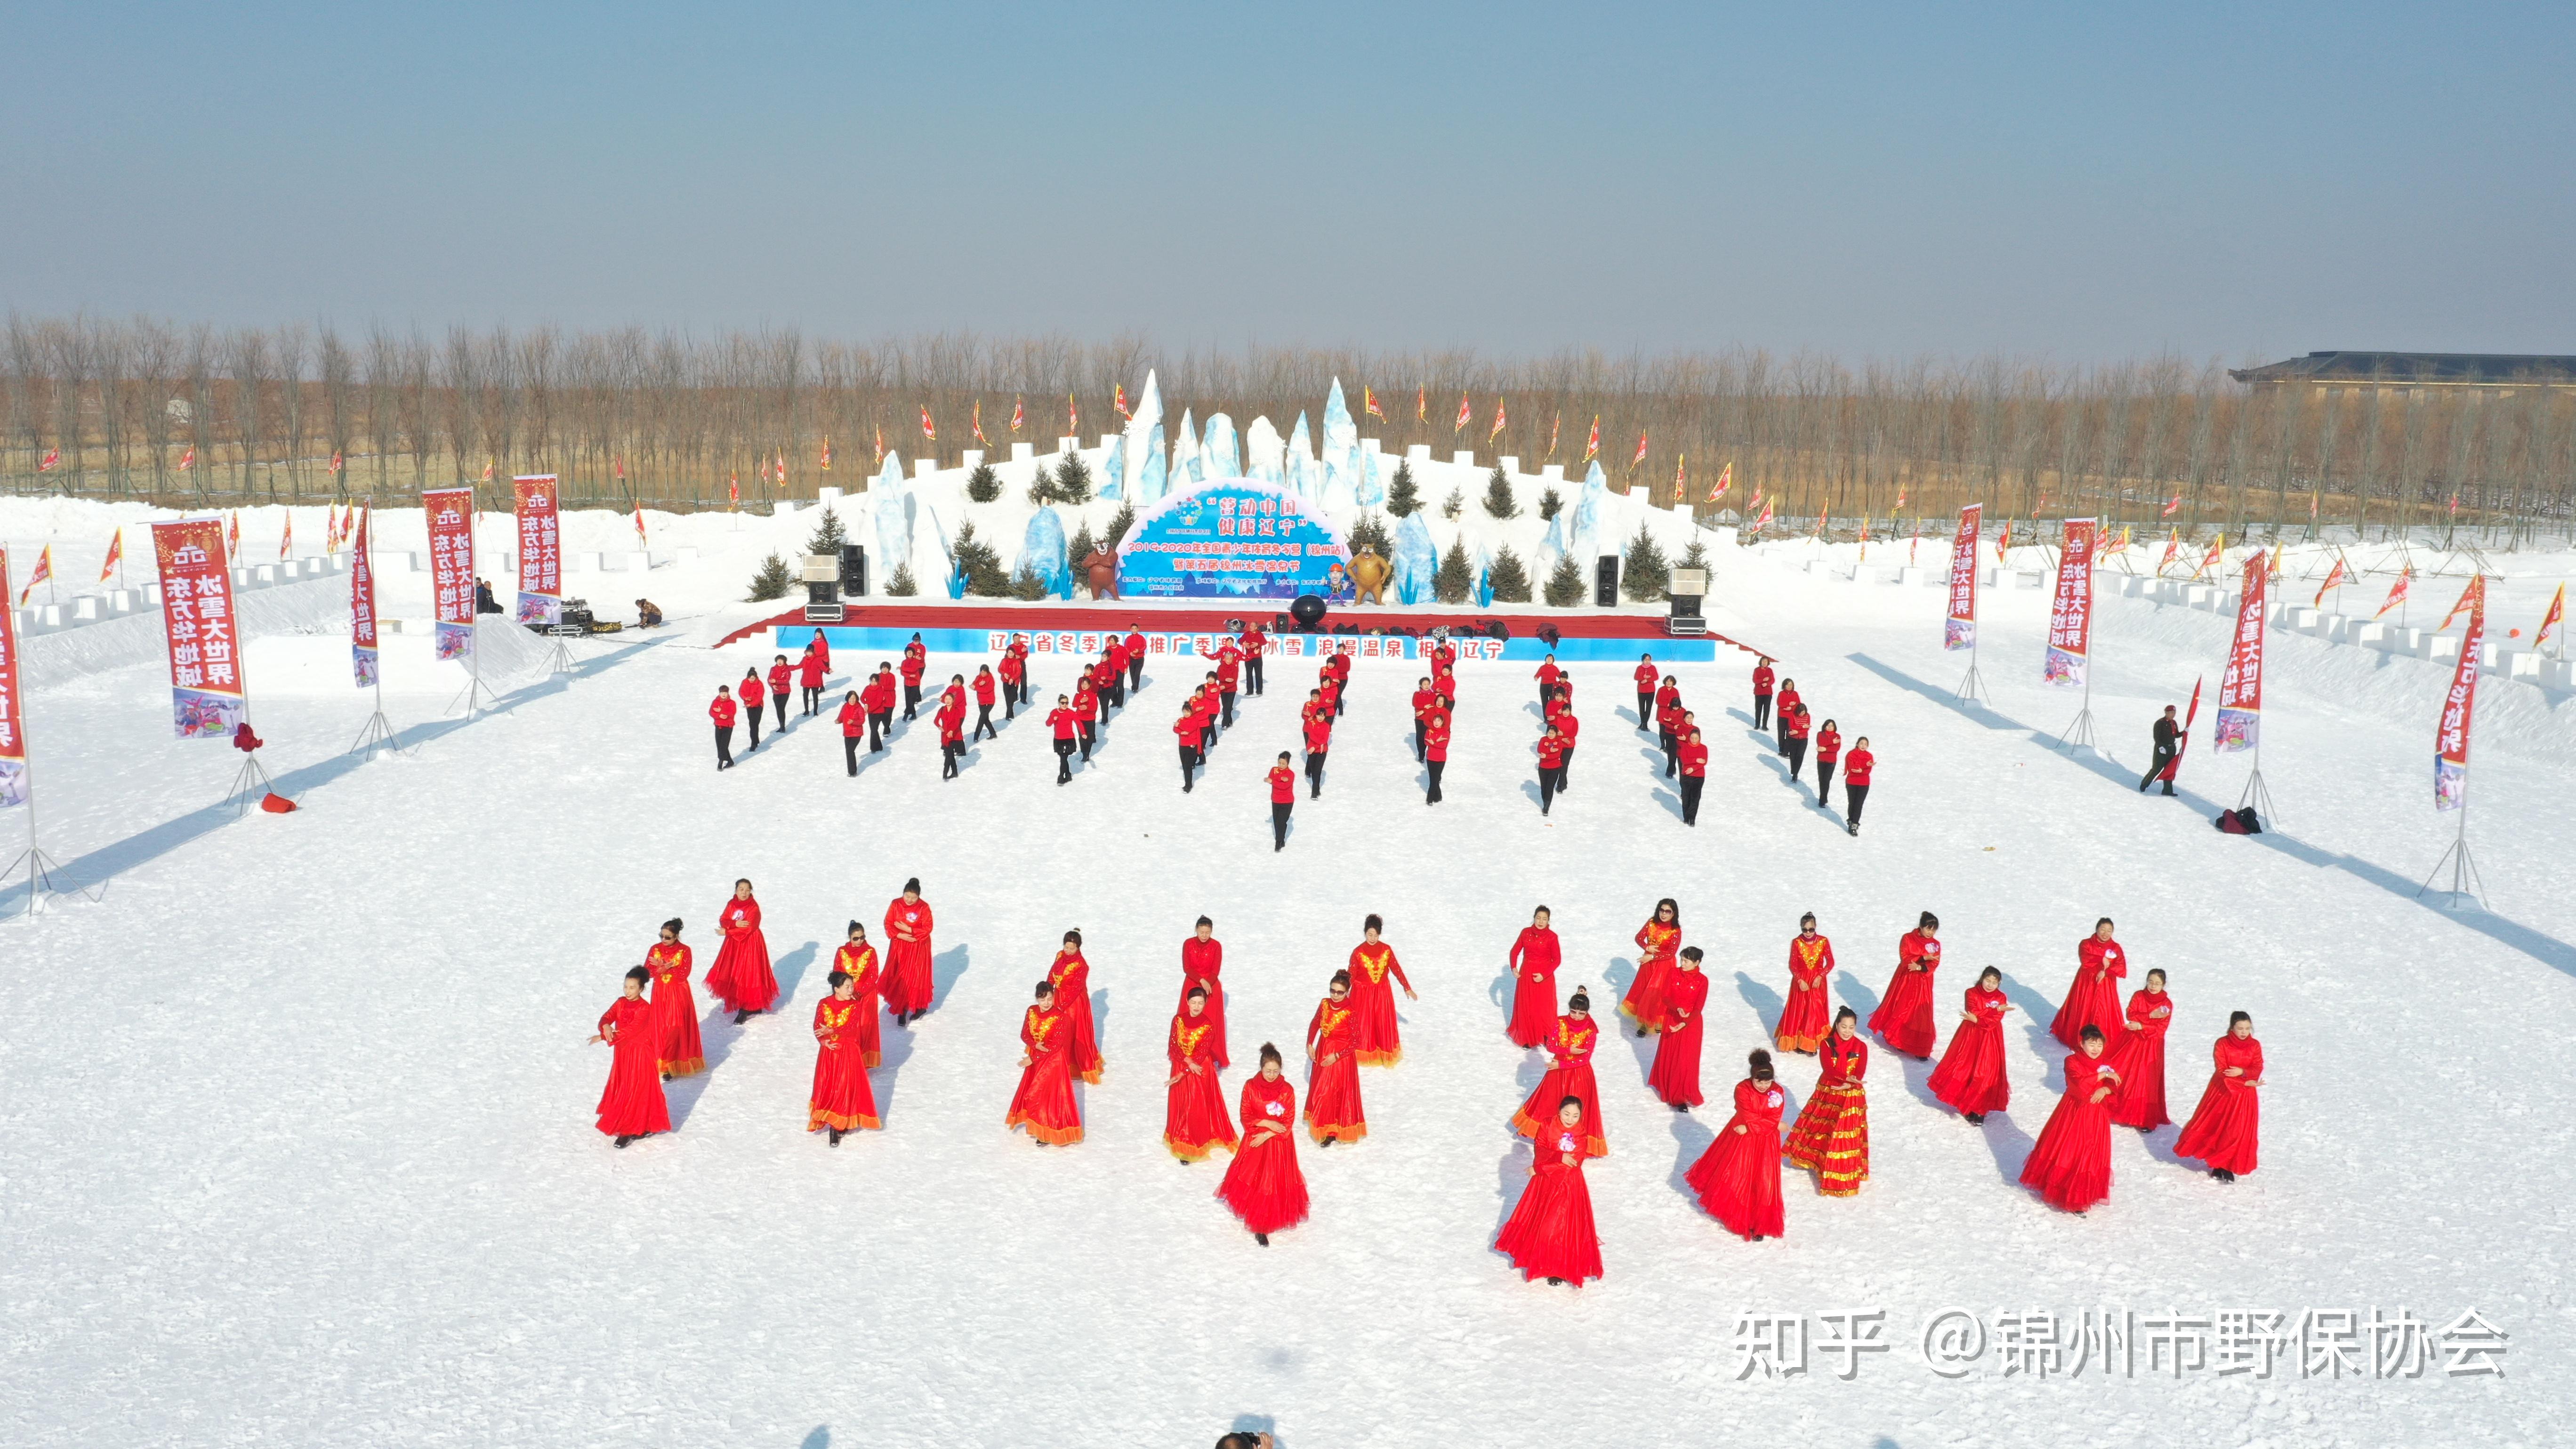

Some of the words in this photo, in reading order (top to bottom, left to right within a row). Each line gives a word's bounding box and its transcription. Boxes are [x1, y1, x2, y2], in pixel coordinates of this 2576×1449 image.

[1218, 518, 1307, 537] 健康辽宁”
[1173, 558, 1300, 573] 暨第五届锦州冰雪温泉节
